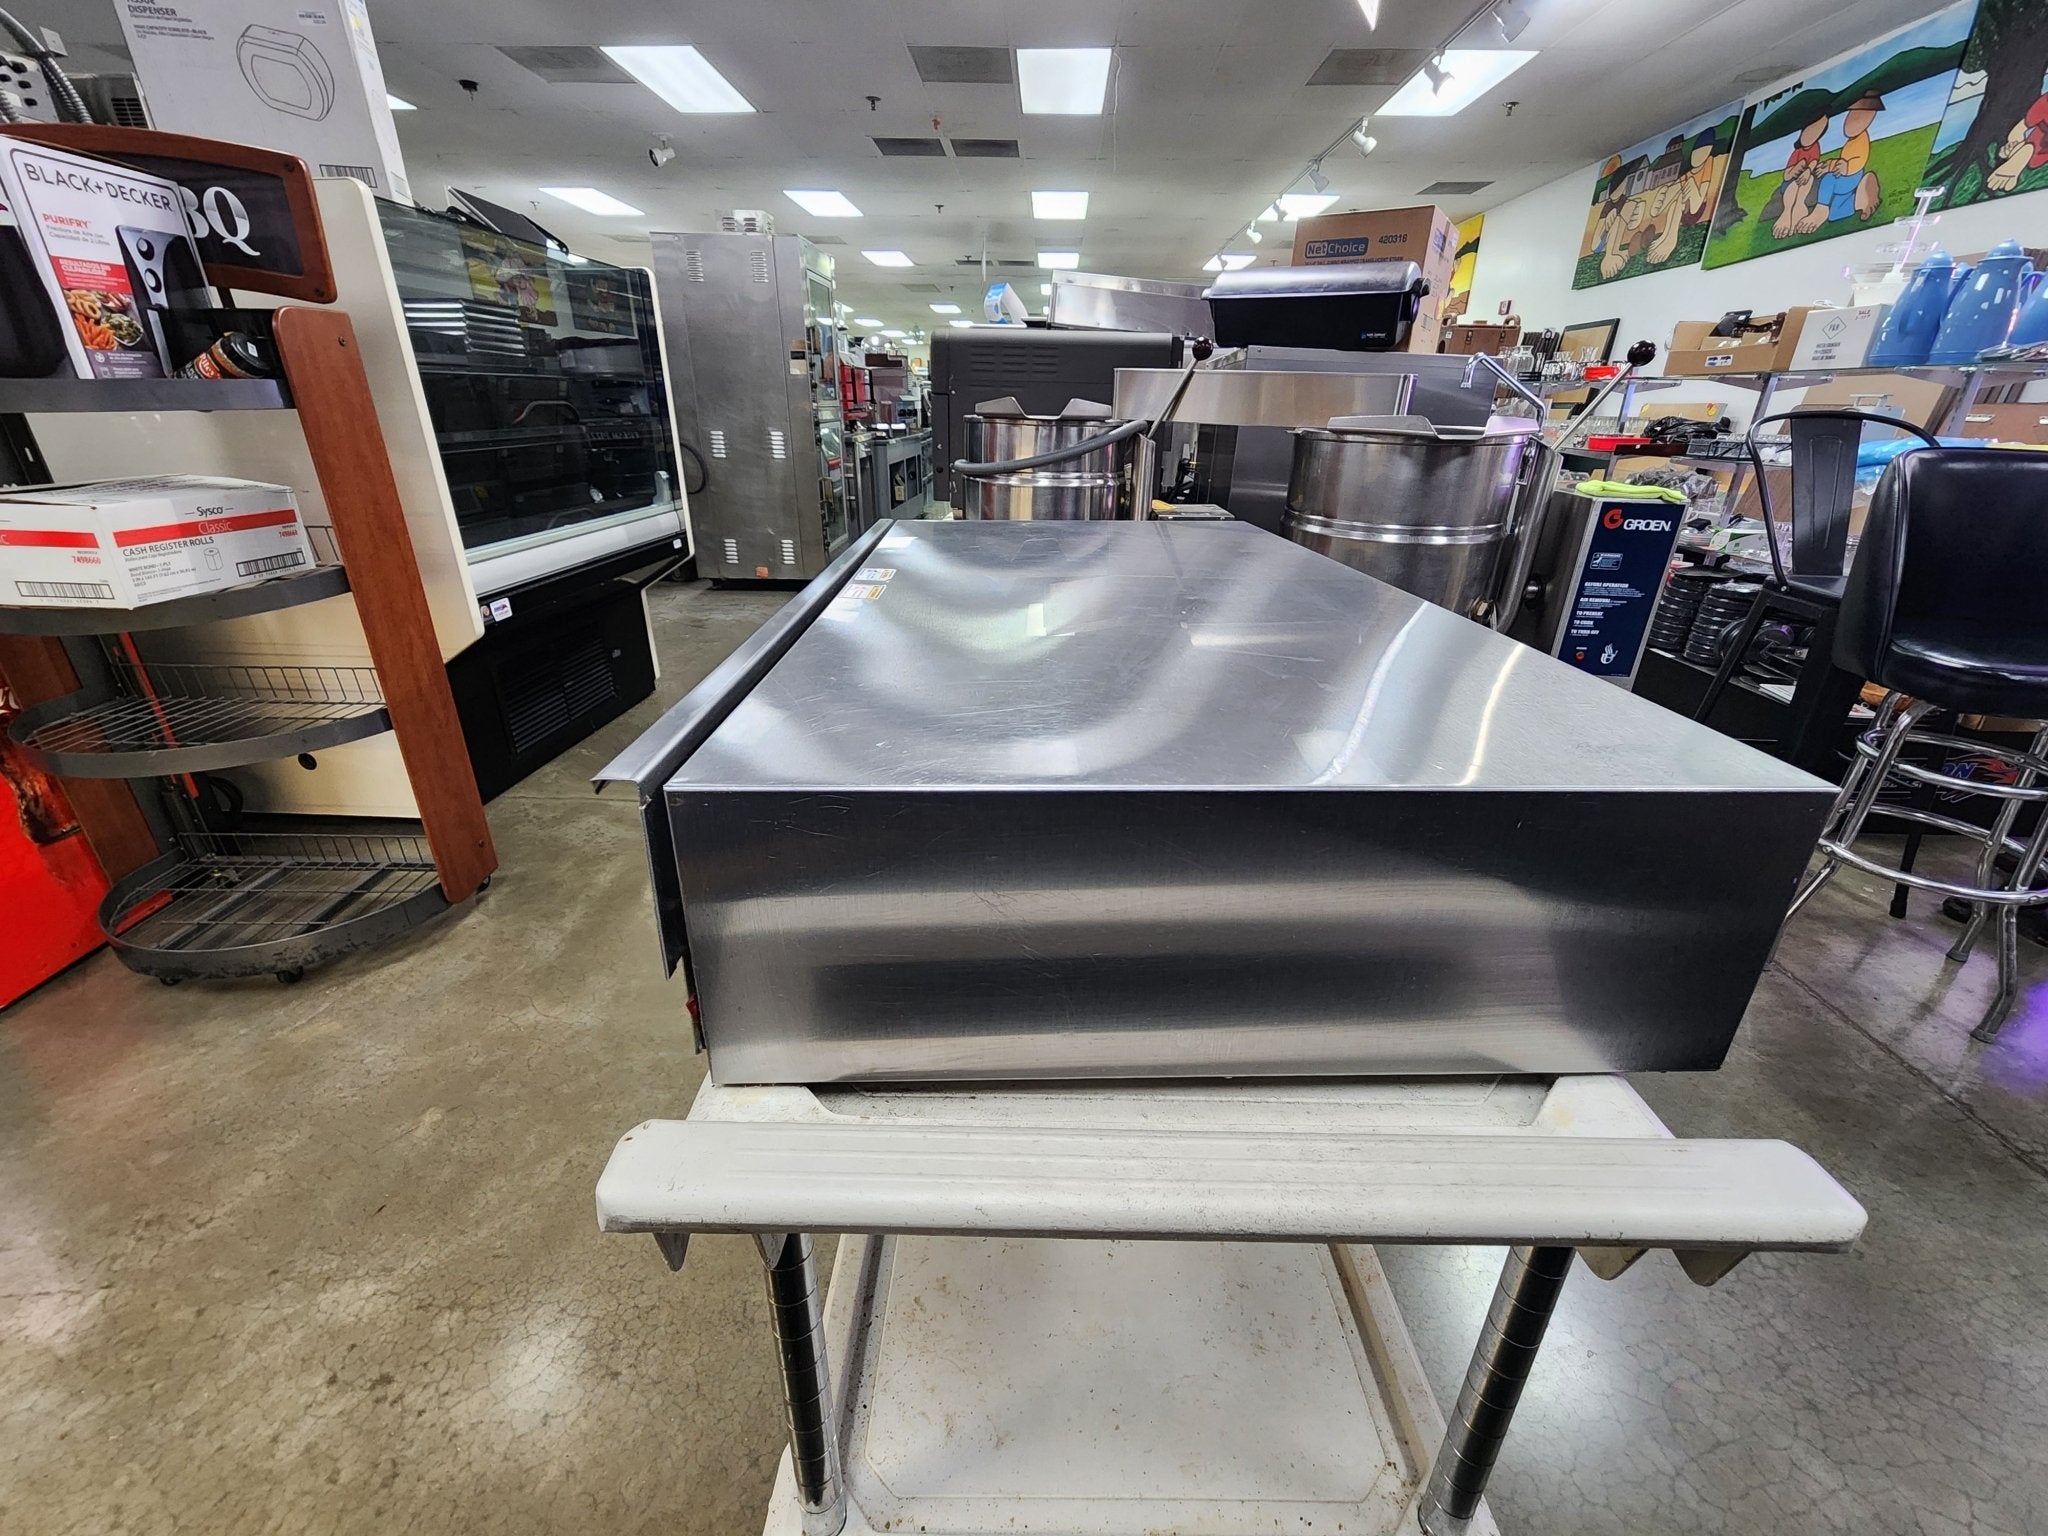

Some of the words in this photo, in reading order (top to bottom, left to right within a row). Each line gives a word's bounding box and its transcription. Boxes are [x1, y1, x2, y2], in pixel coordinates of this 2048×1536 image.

[127, 4, 177, 16] DISPENSER
[23, 162, 173, 212] BLACK+DECKER
[42, 213, 89, 228] PURIFRY
[1307, 242, 1367, 256] NetChoice
[196, 505, 224, 518] Sysco
[198, 520, 233, 535] Classic
[1623, 519, 1671, 532] GROEN
[122, 546, 148, 557] CASH
[148, 540, 189, 553] REGISTER
[189, 536, 215, 546] ROLLS
